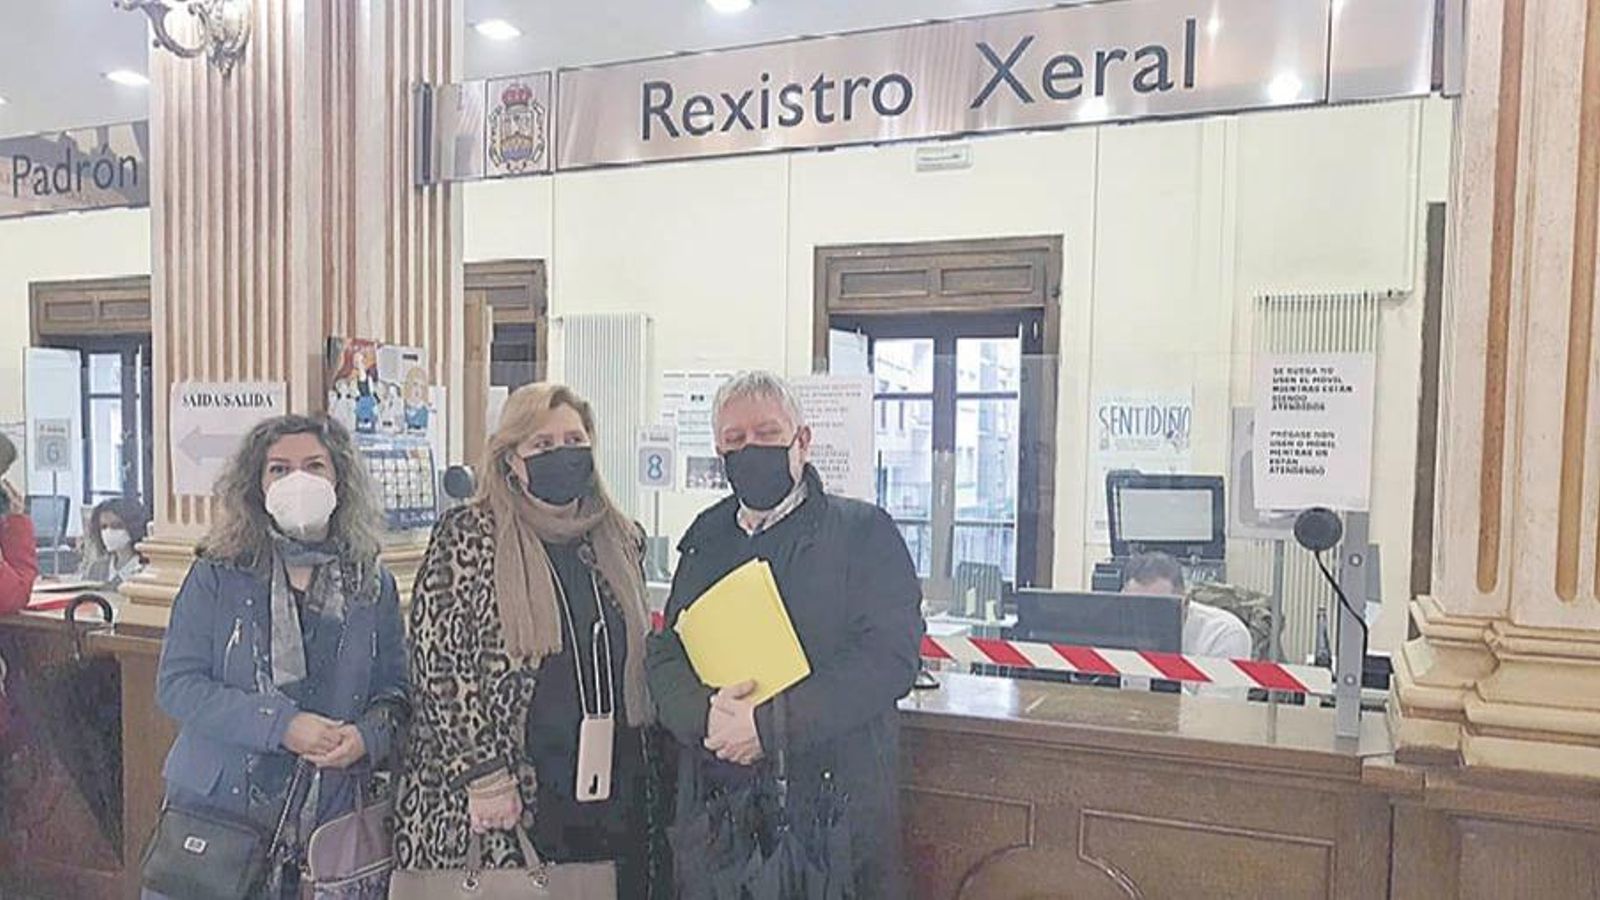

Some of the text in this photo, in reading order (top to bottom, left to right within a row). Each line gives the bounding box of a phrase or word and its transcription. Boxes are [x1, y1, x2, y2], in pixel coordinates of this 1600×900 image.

[642, 18, 1197, 140] Rexistro Xeral
[12, 143, 138, 199] Padrón
[648, 454, 663, 481] 8
